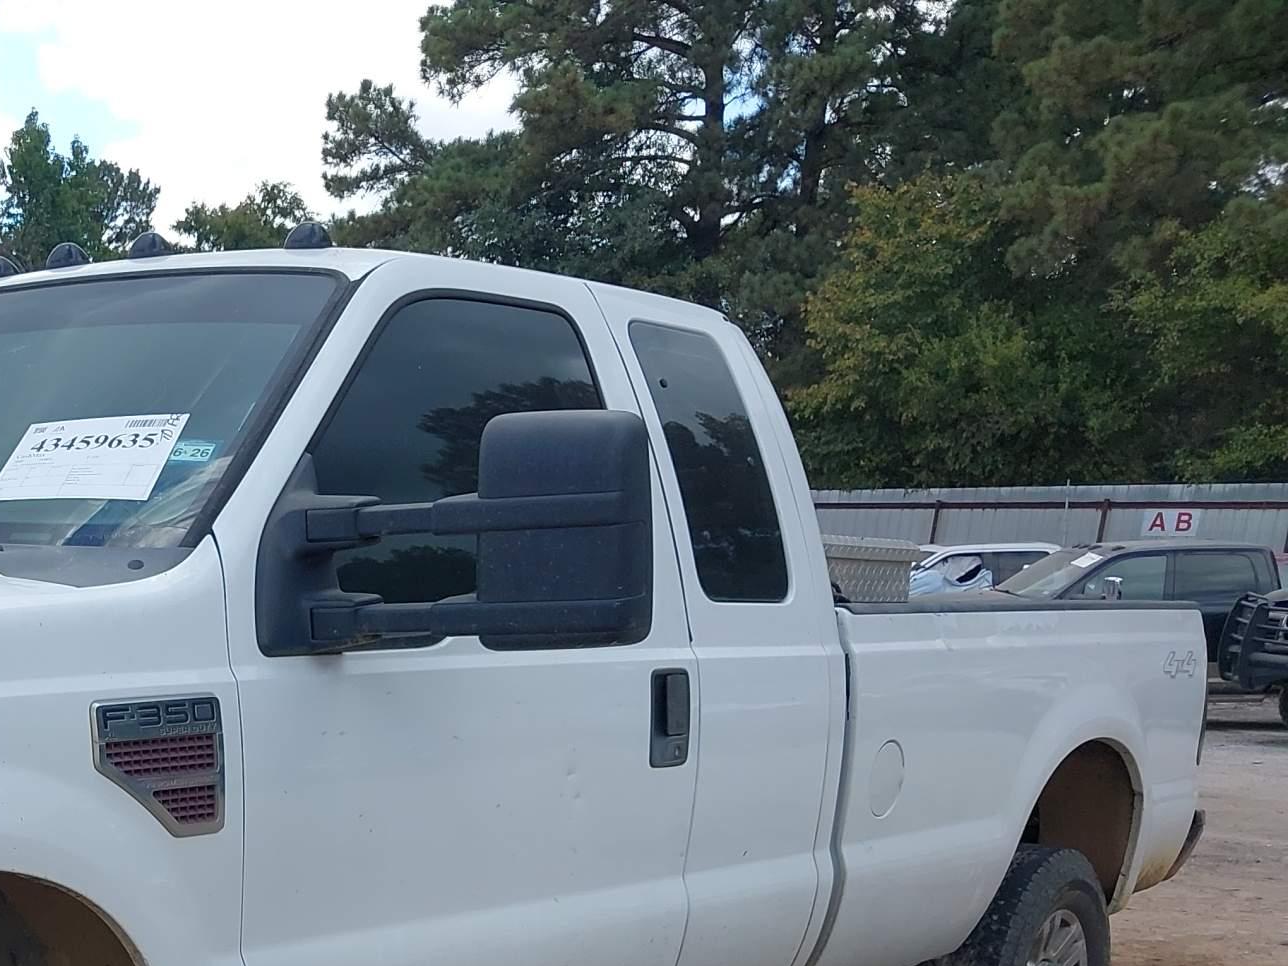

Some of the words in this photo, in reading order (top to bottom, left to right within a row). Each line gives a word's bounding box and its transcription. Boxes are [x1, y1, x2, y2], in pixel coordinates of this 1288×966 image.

[30, 432, 159, 453] 43459635
[1148, 512, 1165, 532] A
[1175, 512, 1193, 532] B
[102, 701, 217, 732] F-350
